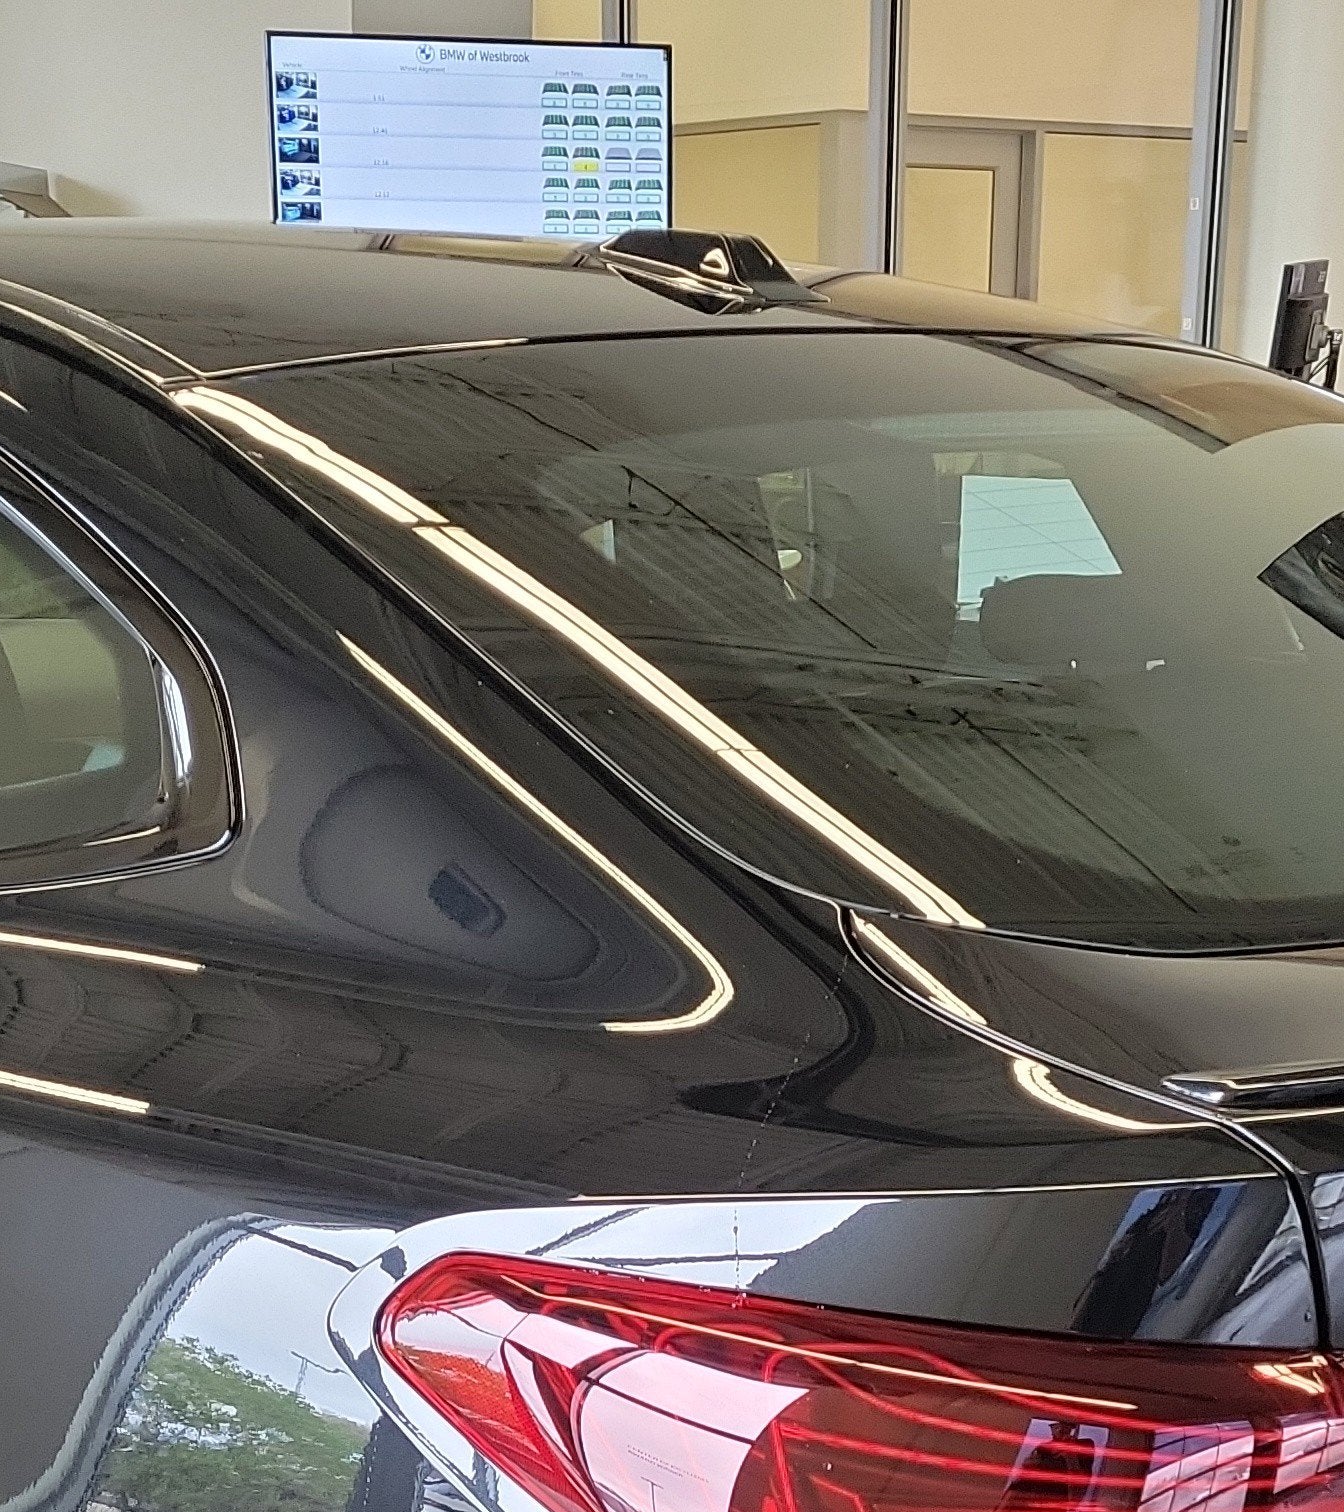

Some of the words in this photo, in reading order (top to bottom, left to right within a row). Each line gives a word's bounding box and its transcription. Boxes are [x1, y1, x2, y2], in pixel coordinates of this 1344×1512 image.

[440, 48, 466, 61] BMW
[467, 49, 477, 62] of
[479, 50, 530, 63] Westbrook
